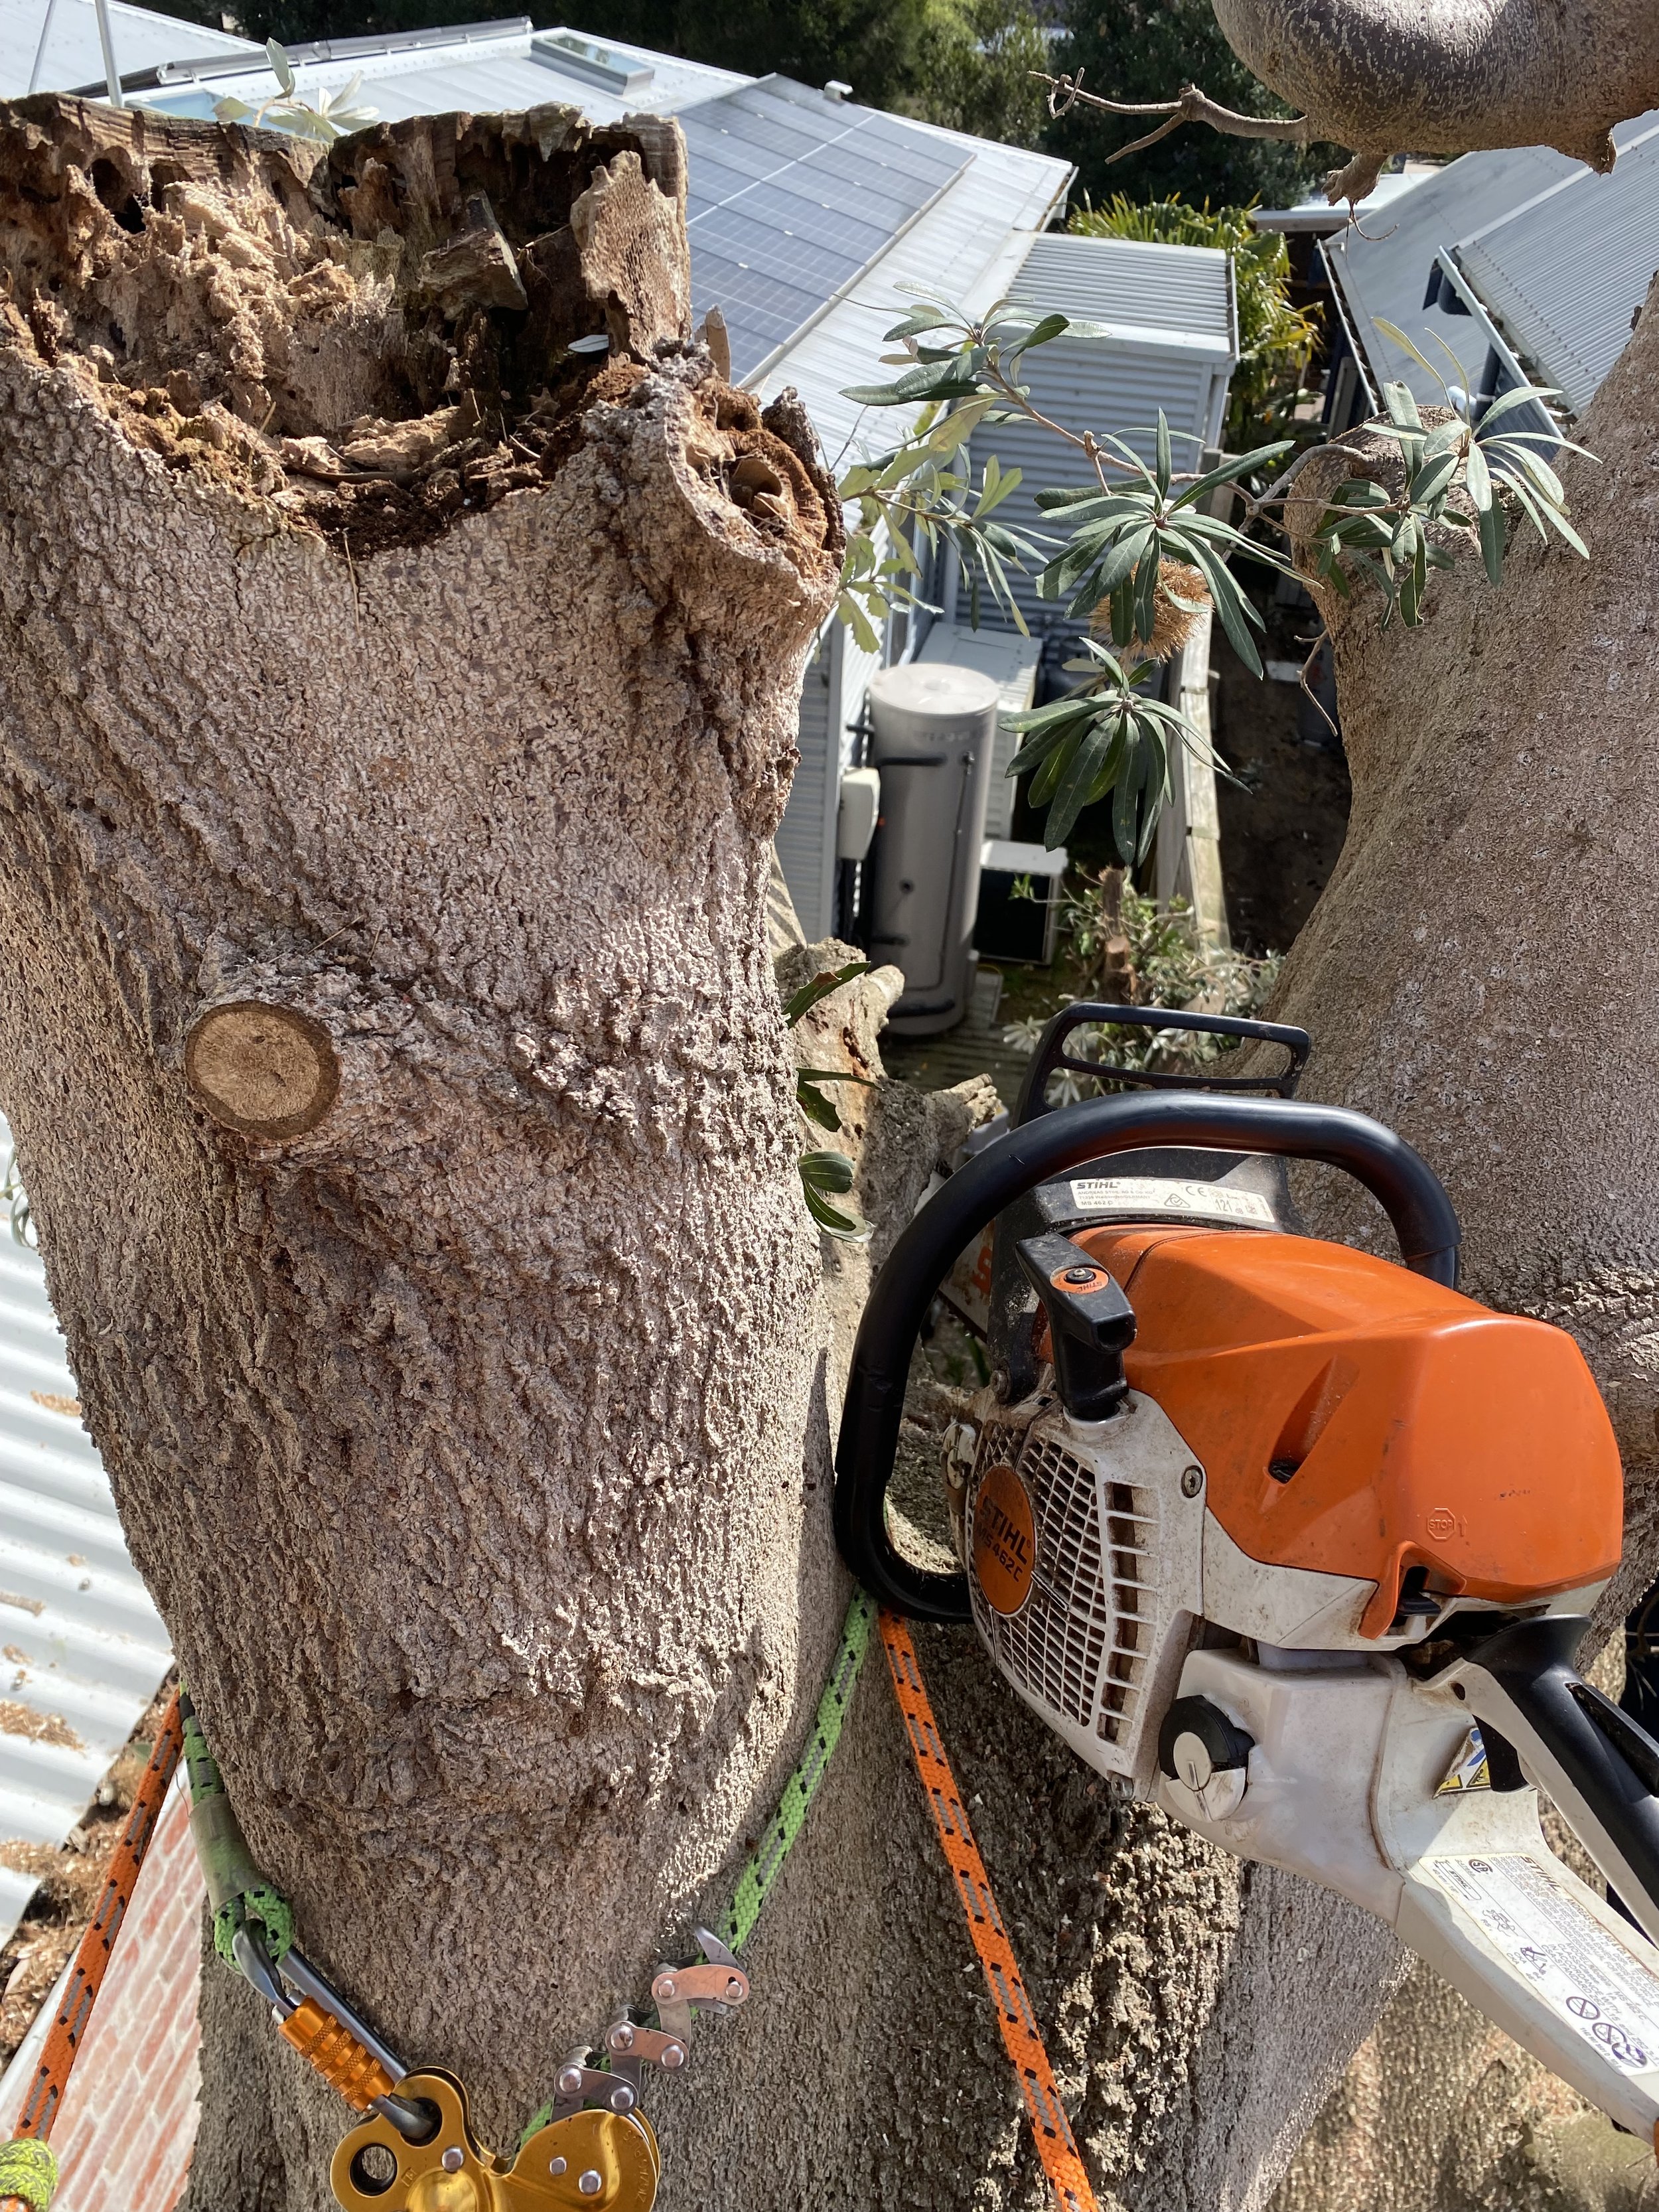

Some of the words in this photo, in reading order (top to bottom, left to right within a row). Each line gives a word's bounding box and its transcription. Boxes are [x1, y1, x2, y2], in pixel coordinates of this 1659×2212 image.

[1215, 1199, 1232, 1213] 121
[1076, 1281, 1102, 1291] STIHL
[979, 1495, 1028, 1565] STIHL
[1429, 1519, 1453, 1528] STOP
[1449, 1870, 1469, 1889] STIHL
[1520, 1856, 1561, 1891] STIHL
[1565, 1899, 1594, 1920] ANDREAS
[1540, 1891, 1563, 1907] ENGINE
[1557, 1908, 1578, 1923] MEETS
[1524, 1891, 1557, 1919] ADJUSTMENT
[1562, 1930, 1593, 1954] CATEGORY
[1540, 1899, 1560, 1913] REFER
[1583, 1942, 1608, 1960] MANUAL
[1506, 1953, 1520, 1964] CKA
[1514, 1952, 1527, 1964] CKA
[1539, 1945, 1594, 1993] CSA-STANDARD
[1619, 2024, 1635, 2035] and
[1555, 1952, 1605, 1995] ACCORDANCE
[1601, 1996, 1622, 2014] WITH
[1613, 1991, 1628, 2001] MS
[1626, 2002, 1640, 2014] 462
